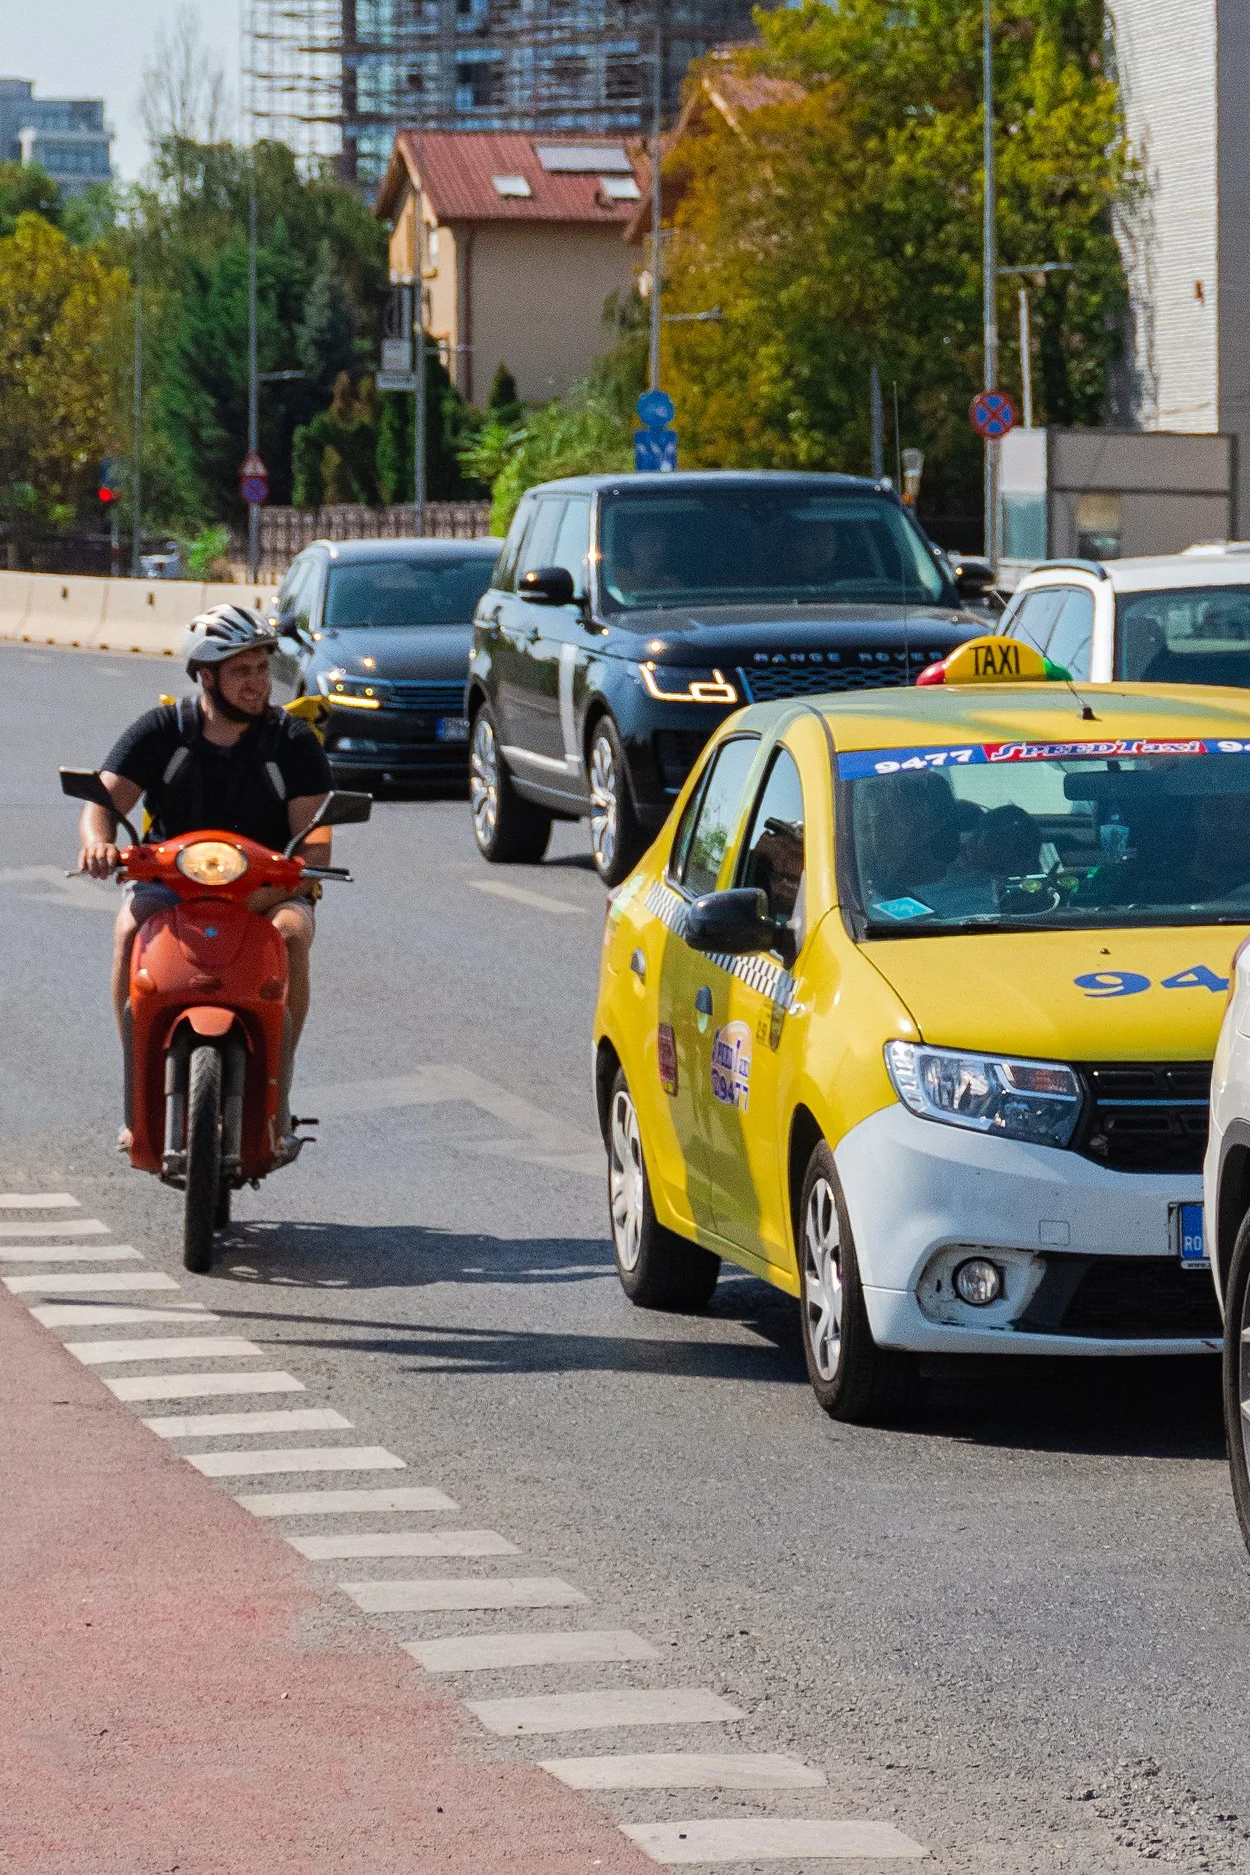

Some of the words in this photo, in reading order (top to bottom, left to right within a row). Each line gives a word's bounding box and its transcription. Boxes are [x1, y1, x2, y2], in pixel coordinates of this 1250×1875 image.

[754, 652, 841, 663] RANGE
[858, 652, 943, 662] ROVER
[969, 644, 1020, 676] TAXI
[874, 749, 973, 774] 9477
[1073, 964, 1230, 998] 94
[1184, 1236, 1203, 1251] RO
